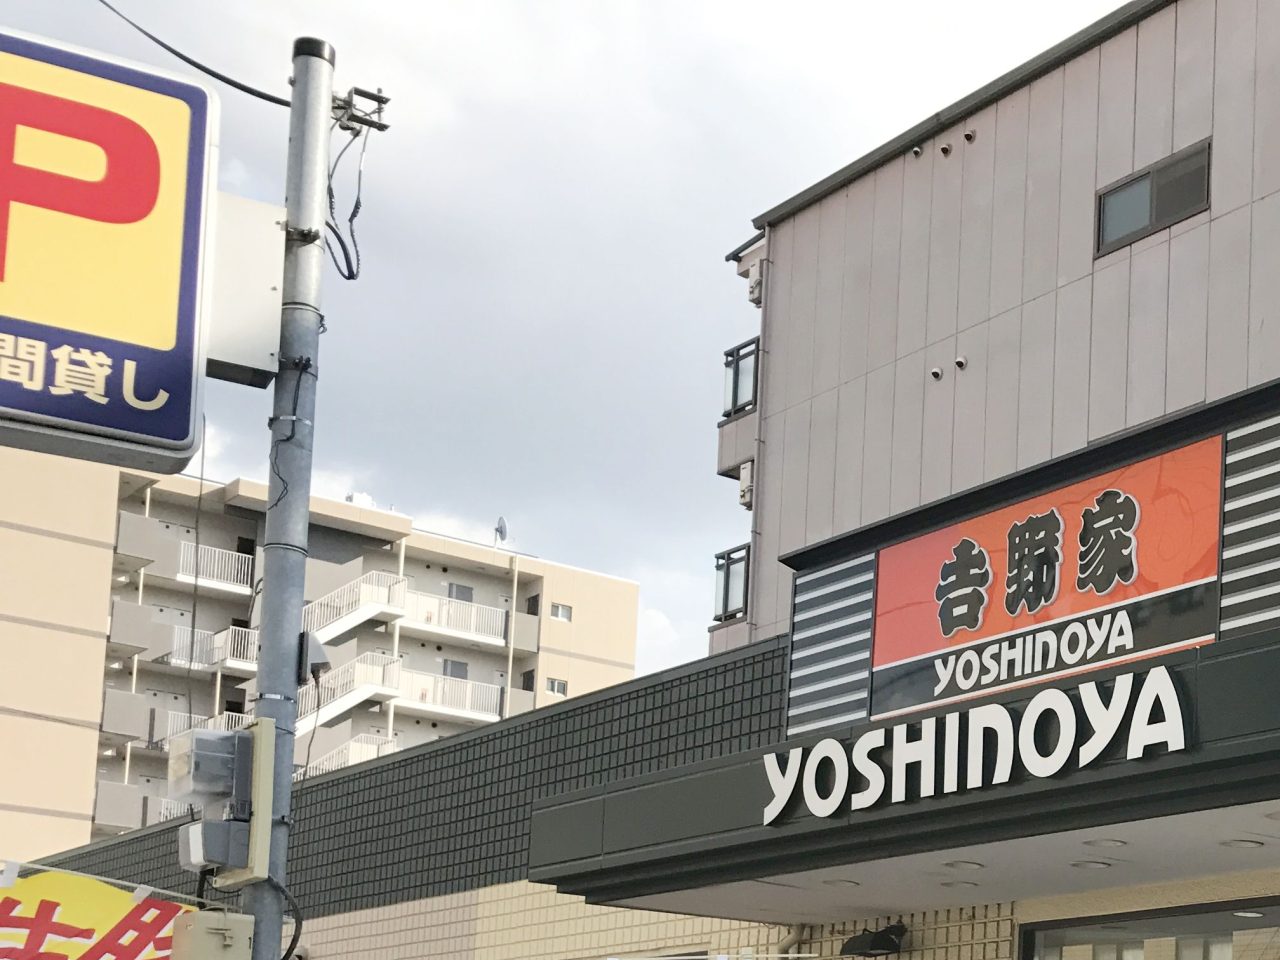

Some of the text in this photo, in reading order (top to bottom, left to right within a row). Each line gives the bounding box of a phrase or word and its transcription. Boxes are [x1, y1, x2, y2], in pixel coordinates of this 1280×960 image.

[0, 82, 161, 283] P
[935, 489, 1141, 637] 吉野家
[934, 609, 1134, 696] YOSHINOYA
[763, 665, 1185, 826] YOSHINOYA
